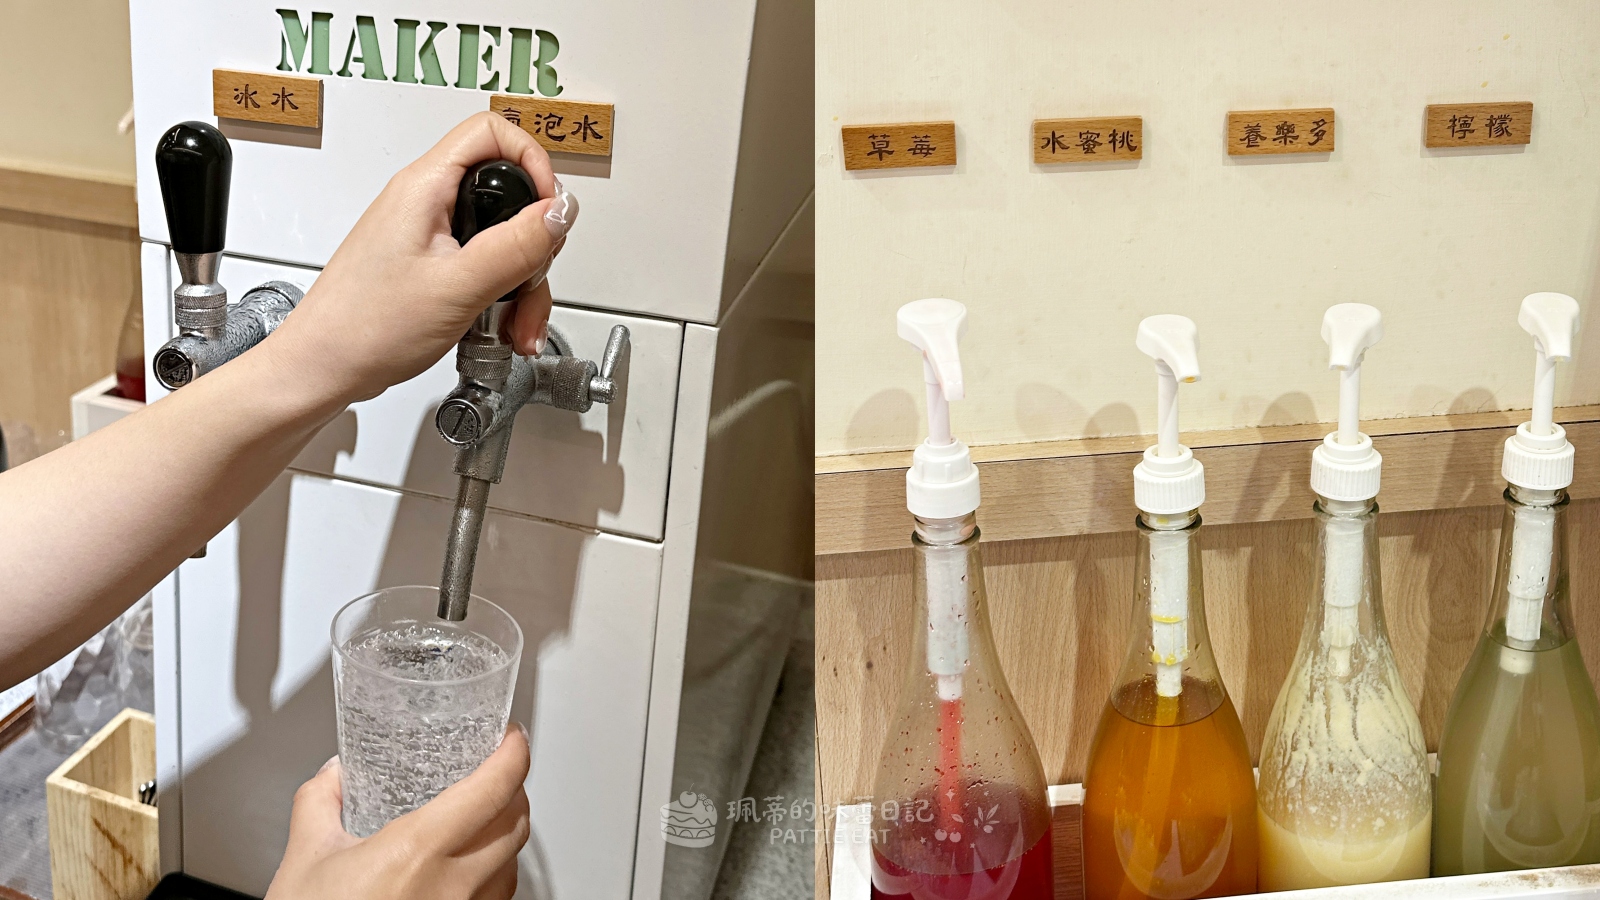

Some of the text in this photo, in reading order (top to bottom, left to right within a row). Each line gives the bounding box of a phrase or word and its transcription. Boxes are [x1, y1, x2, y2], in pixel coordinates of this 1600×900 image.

[275, 8, 563, 97] MAKER
[233, 83, 299, 113] 冰水
[1239, 118, 1328, 148] 養樂多
[1446, 113, 1513, 140] 檸檬
[867, 133, 937, 161] 草莓
[1041, 128, 1138, 155] 水蜜桃
